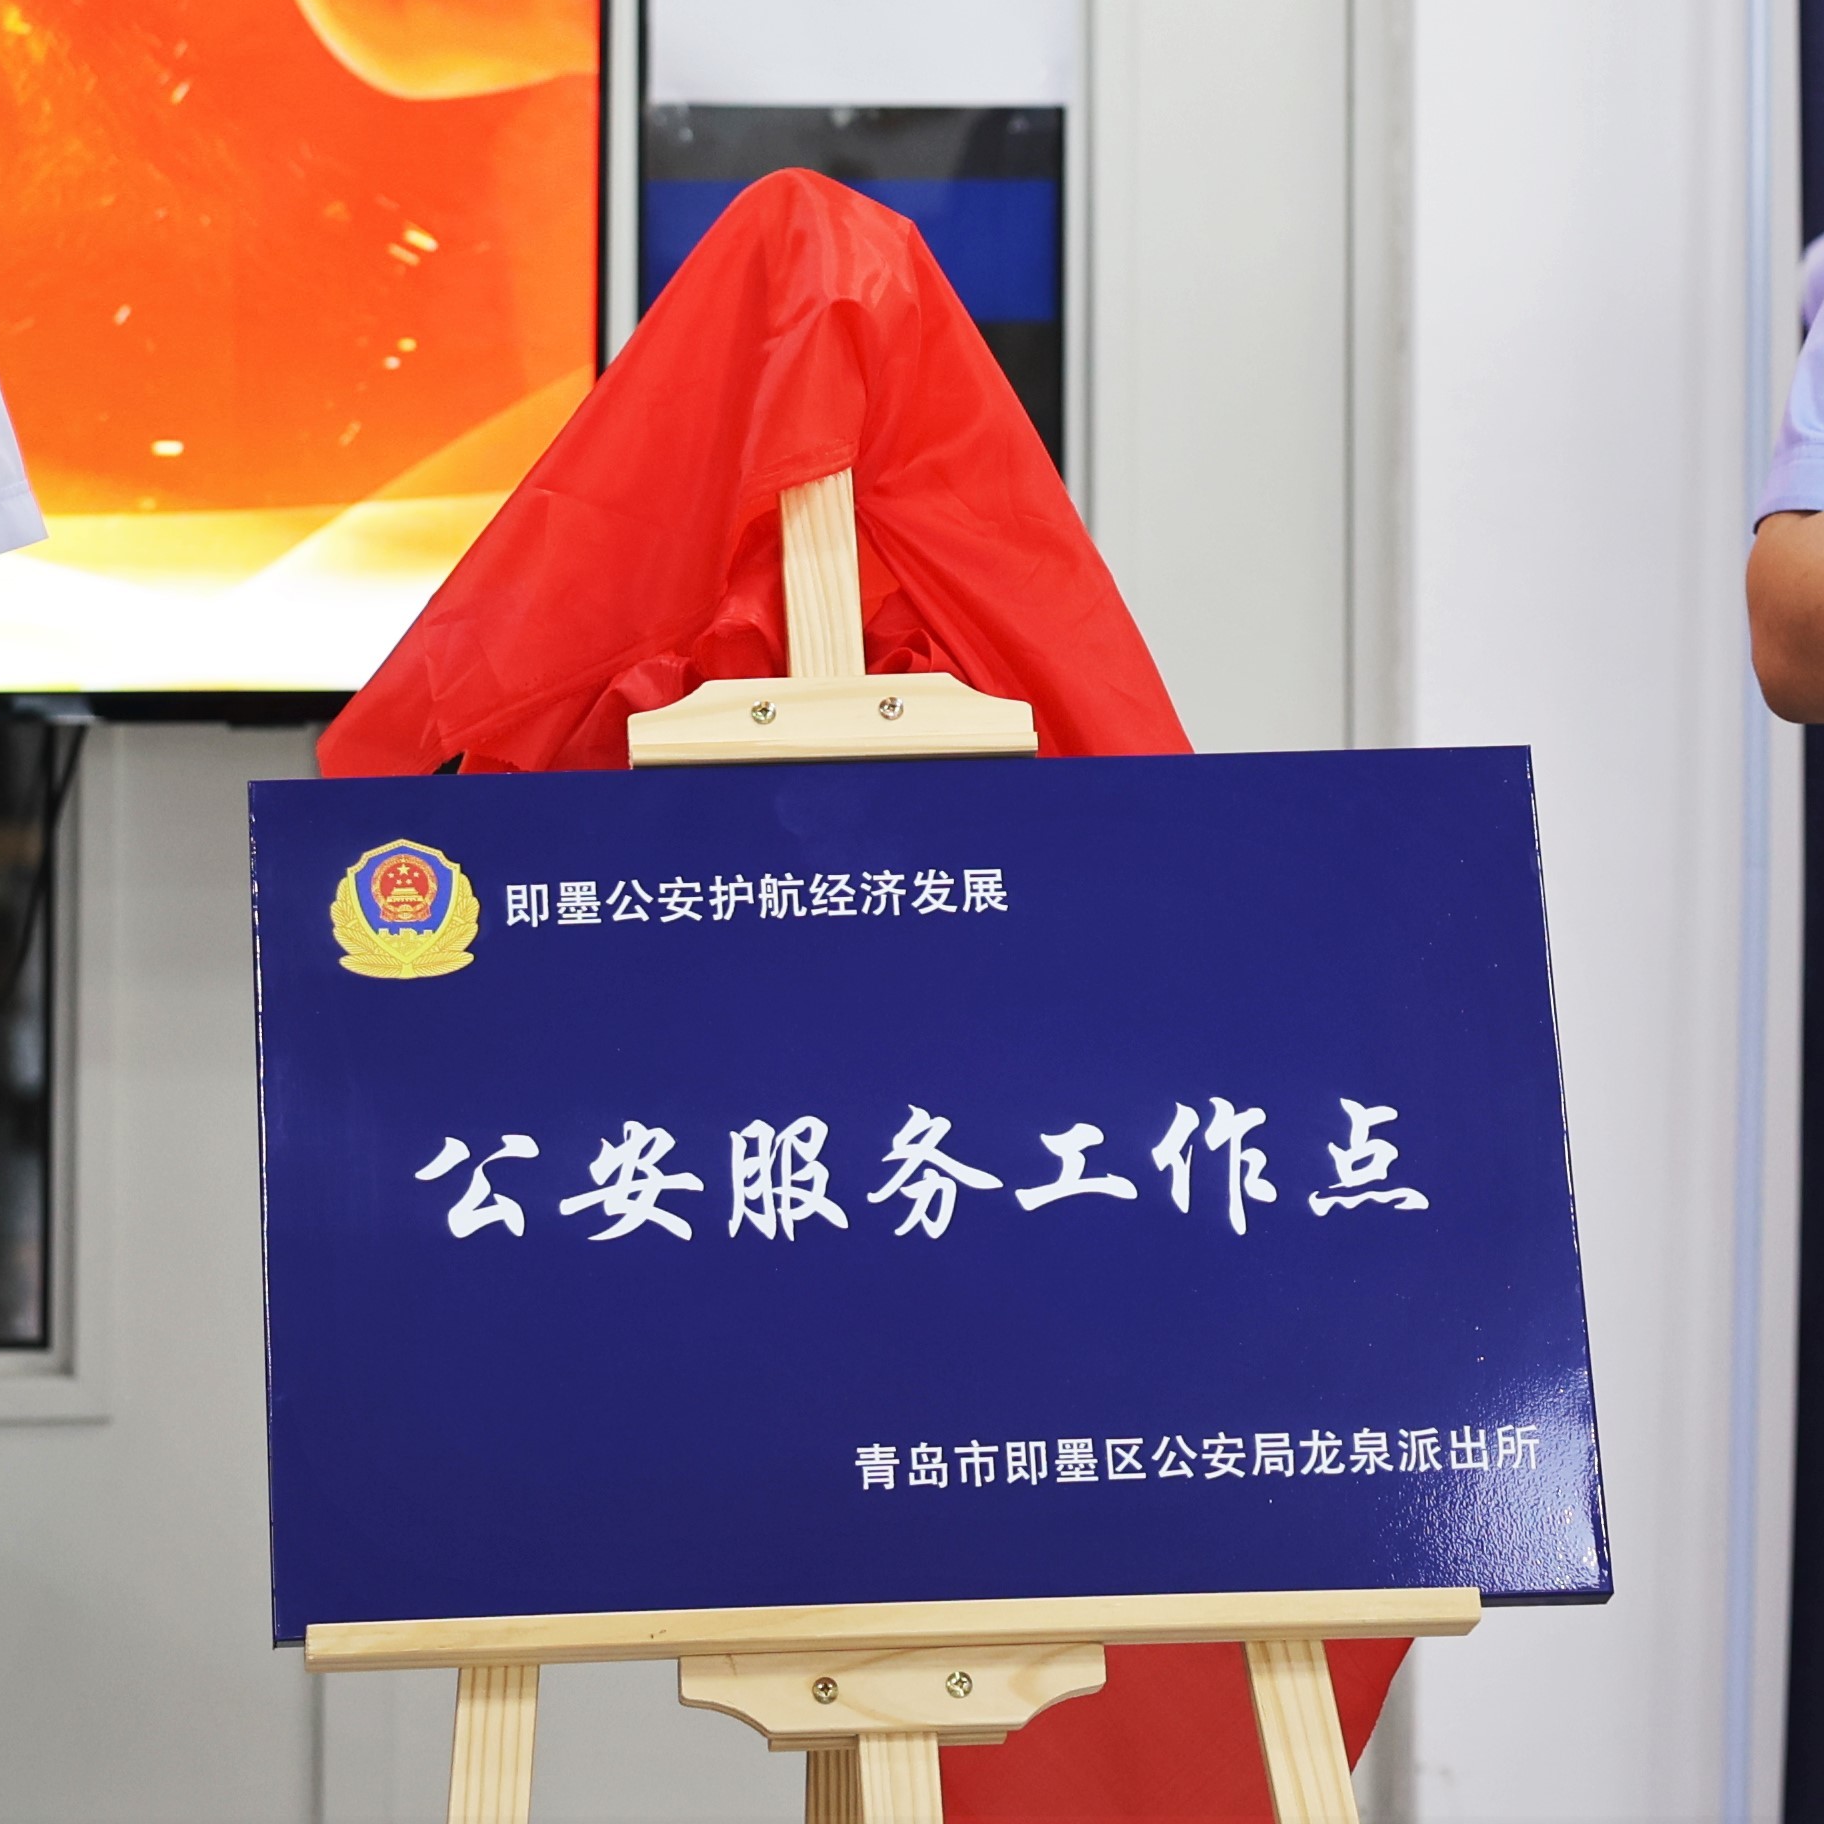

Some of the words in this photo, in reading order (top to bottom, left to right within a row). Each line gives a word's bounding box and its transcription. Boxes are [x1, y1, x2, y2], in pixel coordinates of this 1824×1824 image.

[507, 869, 1008, 927] 即墨公安护航经济发展
[415, 1097, 1429, 1241] 公安服务工作点
[854, 1423, 1540, 1492] 青岛市即墨区公安局龙泉派出所
